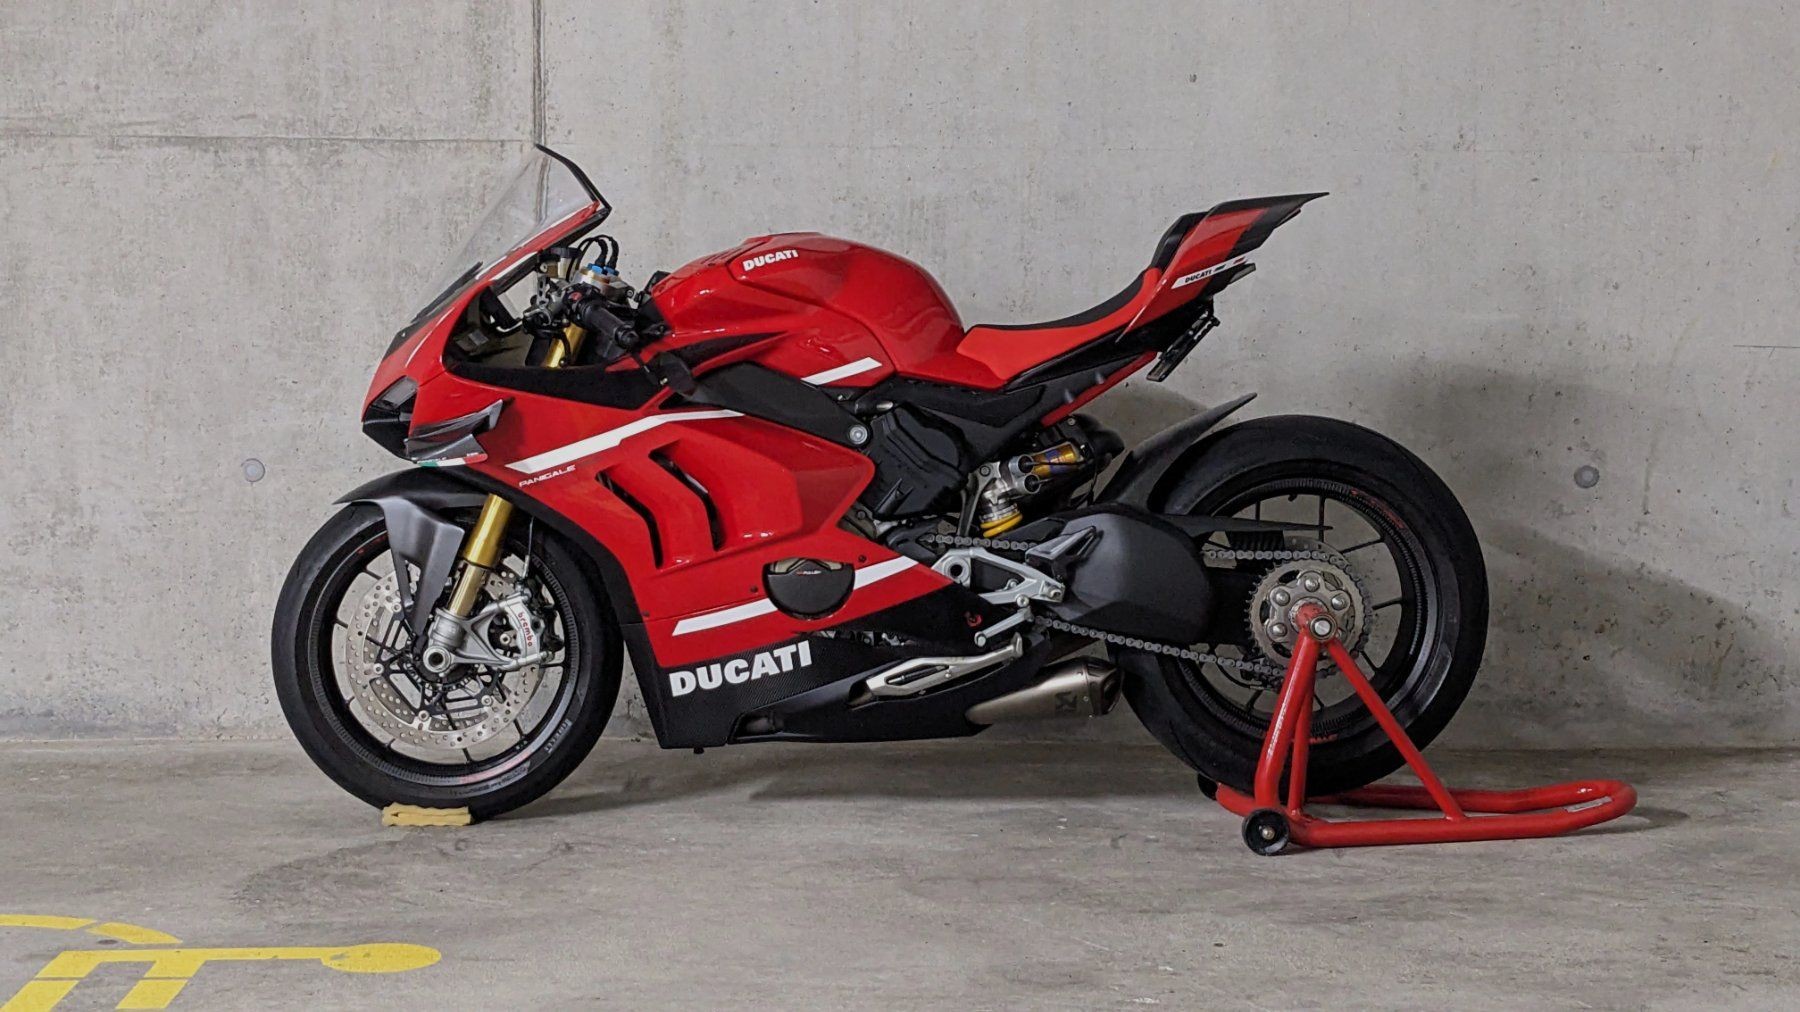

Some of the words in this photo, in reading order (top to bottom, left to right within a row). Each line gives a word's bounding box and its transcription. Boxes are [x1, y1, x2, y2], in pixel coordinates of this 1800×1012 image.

[743, 249, 799, 272] DUCATI
[1185, 269, 1213, 283] DUCATI
[519, 464, 576, 487] PANIGALE
[517, 611, 534, 647] brembo
[669, 640, 813, 697] DUCATI
